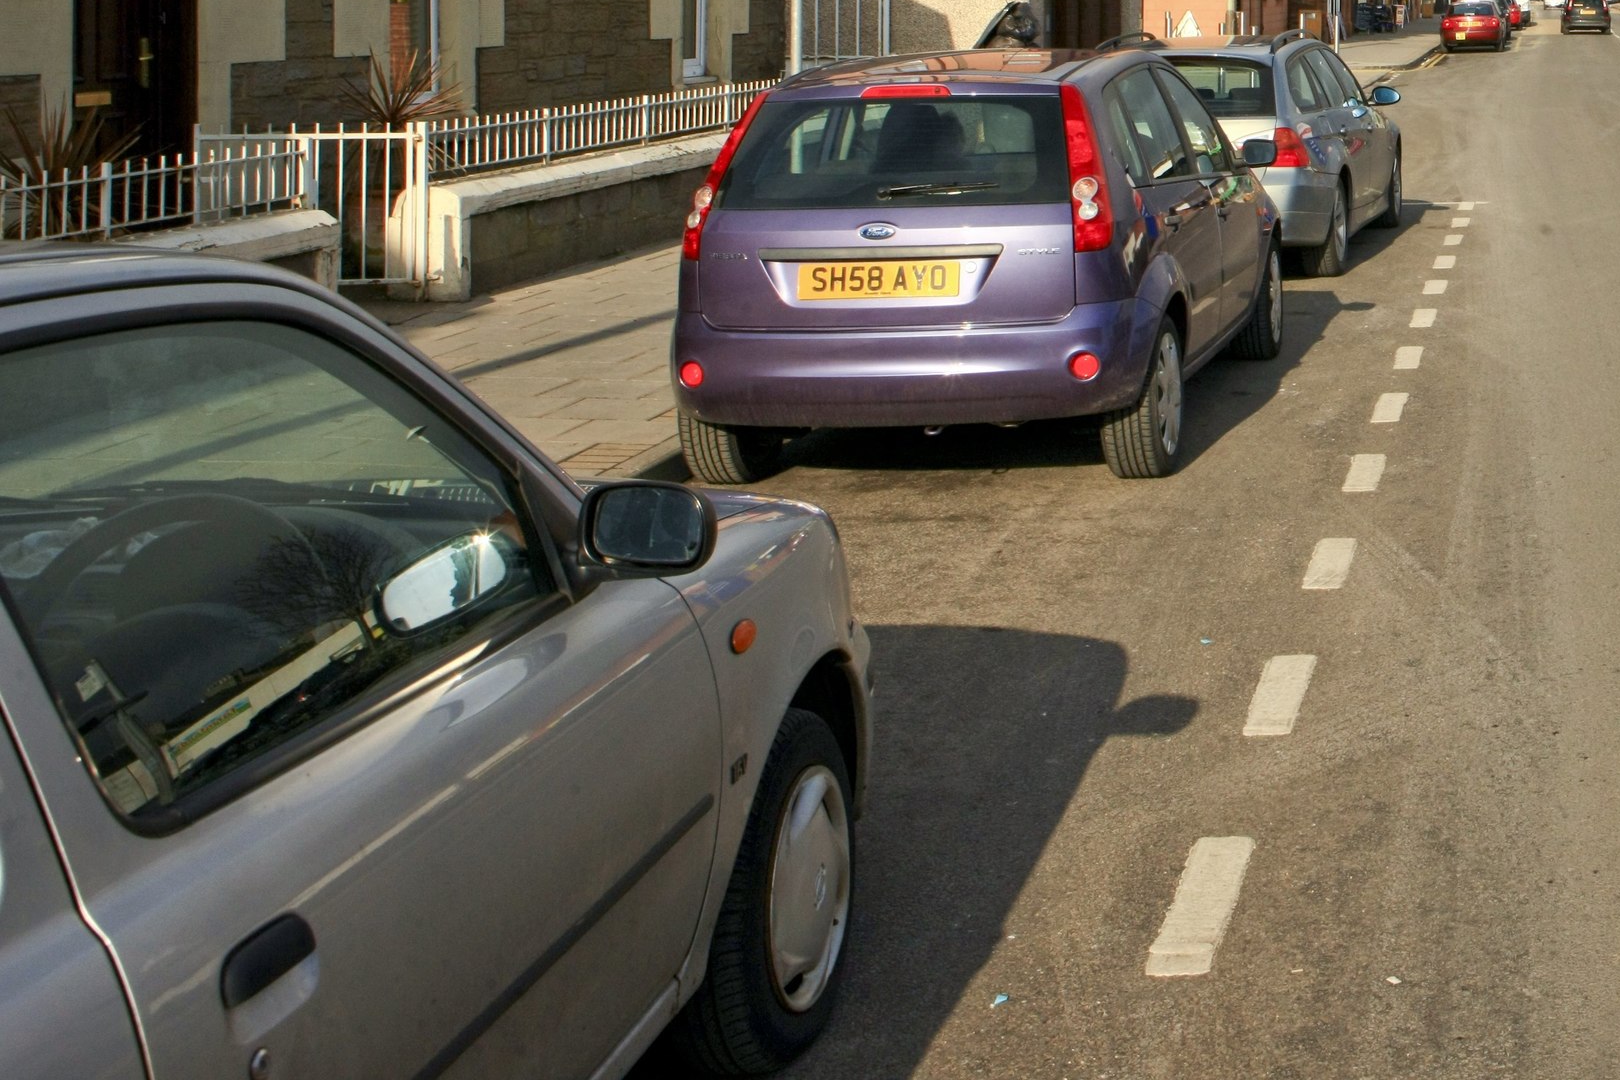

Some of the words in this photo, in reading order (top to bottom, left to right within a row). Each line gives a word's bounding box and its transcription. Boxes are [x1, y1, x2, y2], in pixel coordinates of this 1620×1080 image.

[1017, 247, 1061, 256] STYLE
[811, 266, 884, 292] SH58
[892, 265, 947, 291] AYO
